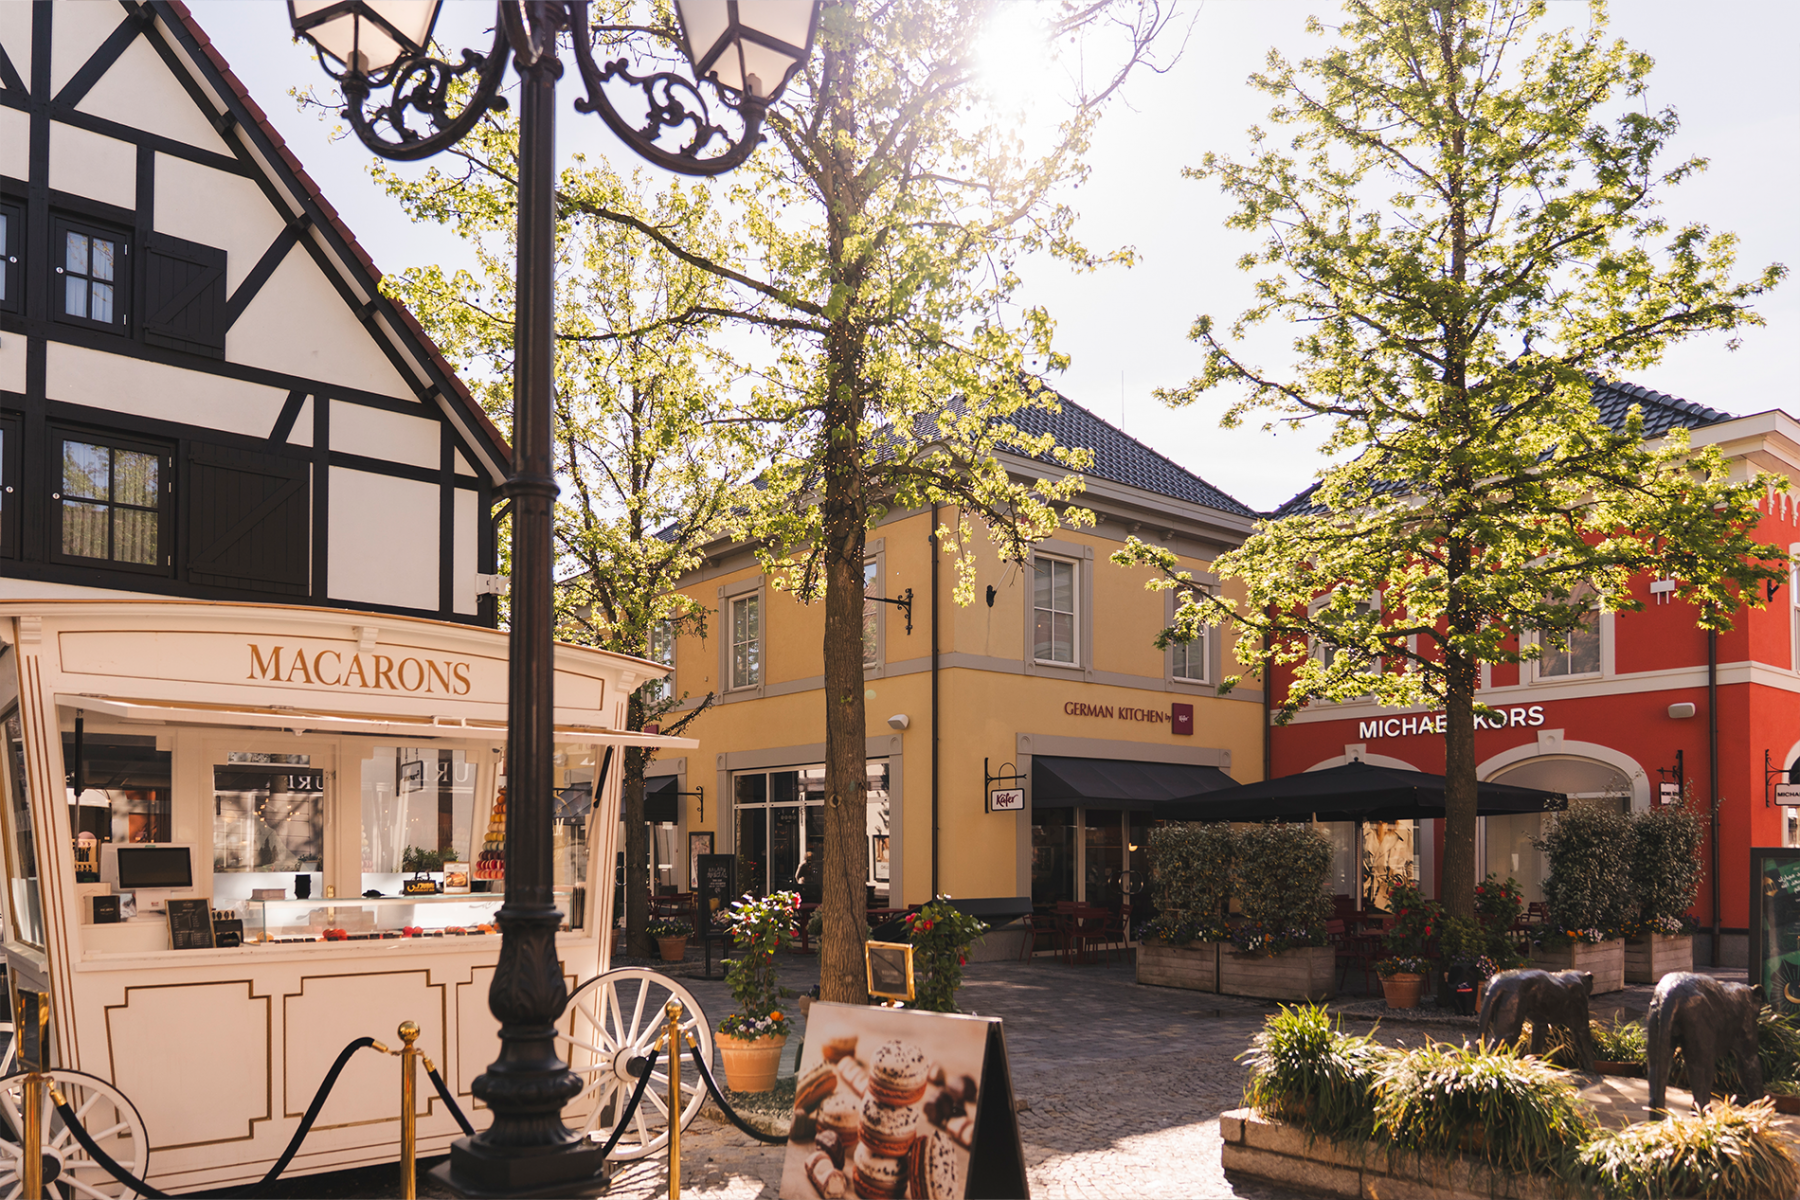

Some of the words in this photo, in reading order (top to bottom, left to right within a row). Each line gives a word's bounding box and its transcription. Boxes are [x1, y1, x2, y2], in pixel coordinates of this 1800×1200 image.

[246, 643, 471, 696] MACARONS
[1064, 701, 1114, 719] GERMAN
[1118, 706, 1164, 724] KITCHEN
[1165, 712, 1172, 724] by
[1359, 714, 1447, 739] MICHAE
[1473, 705, 1545, 730] KORS
[996, 792, 1019, 807] Käfer
